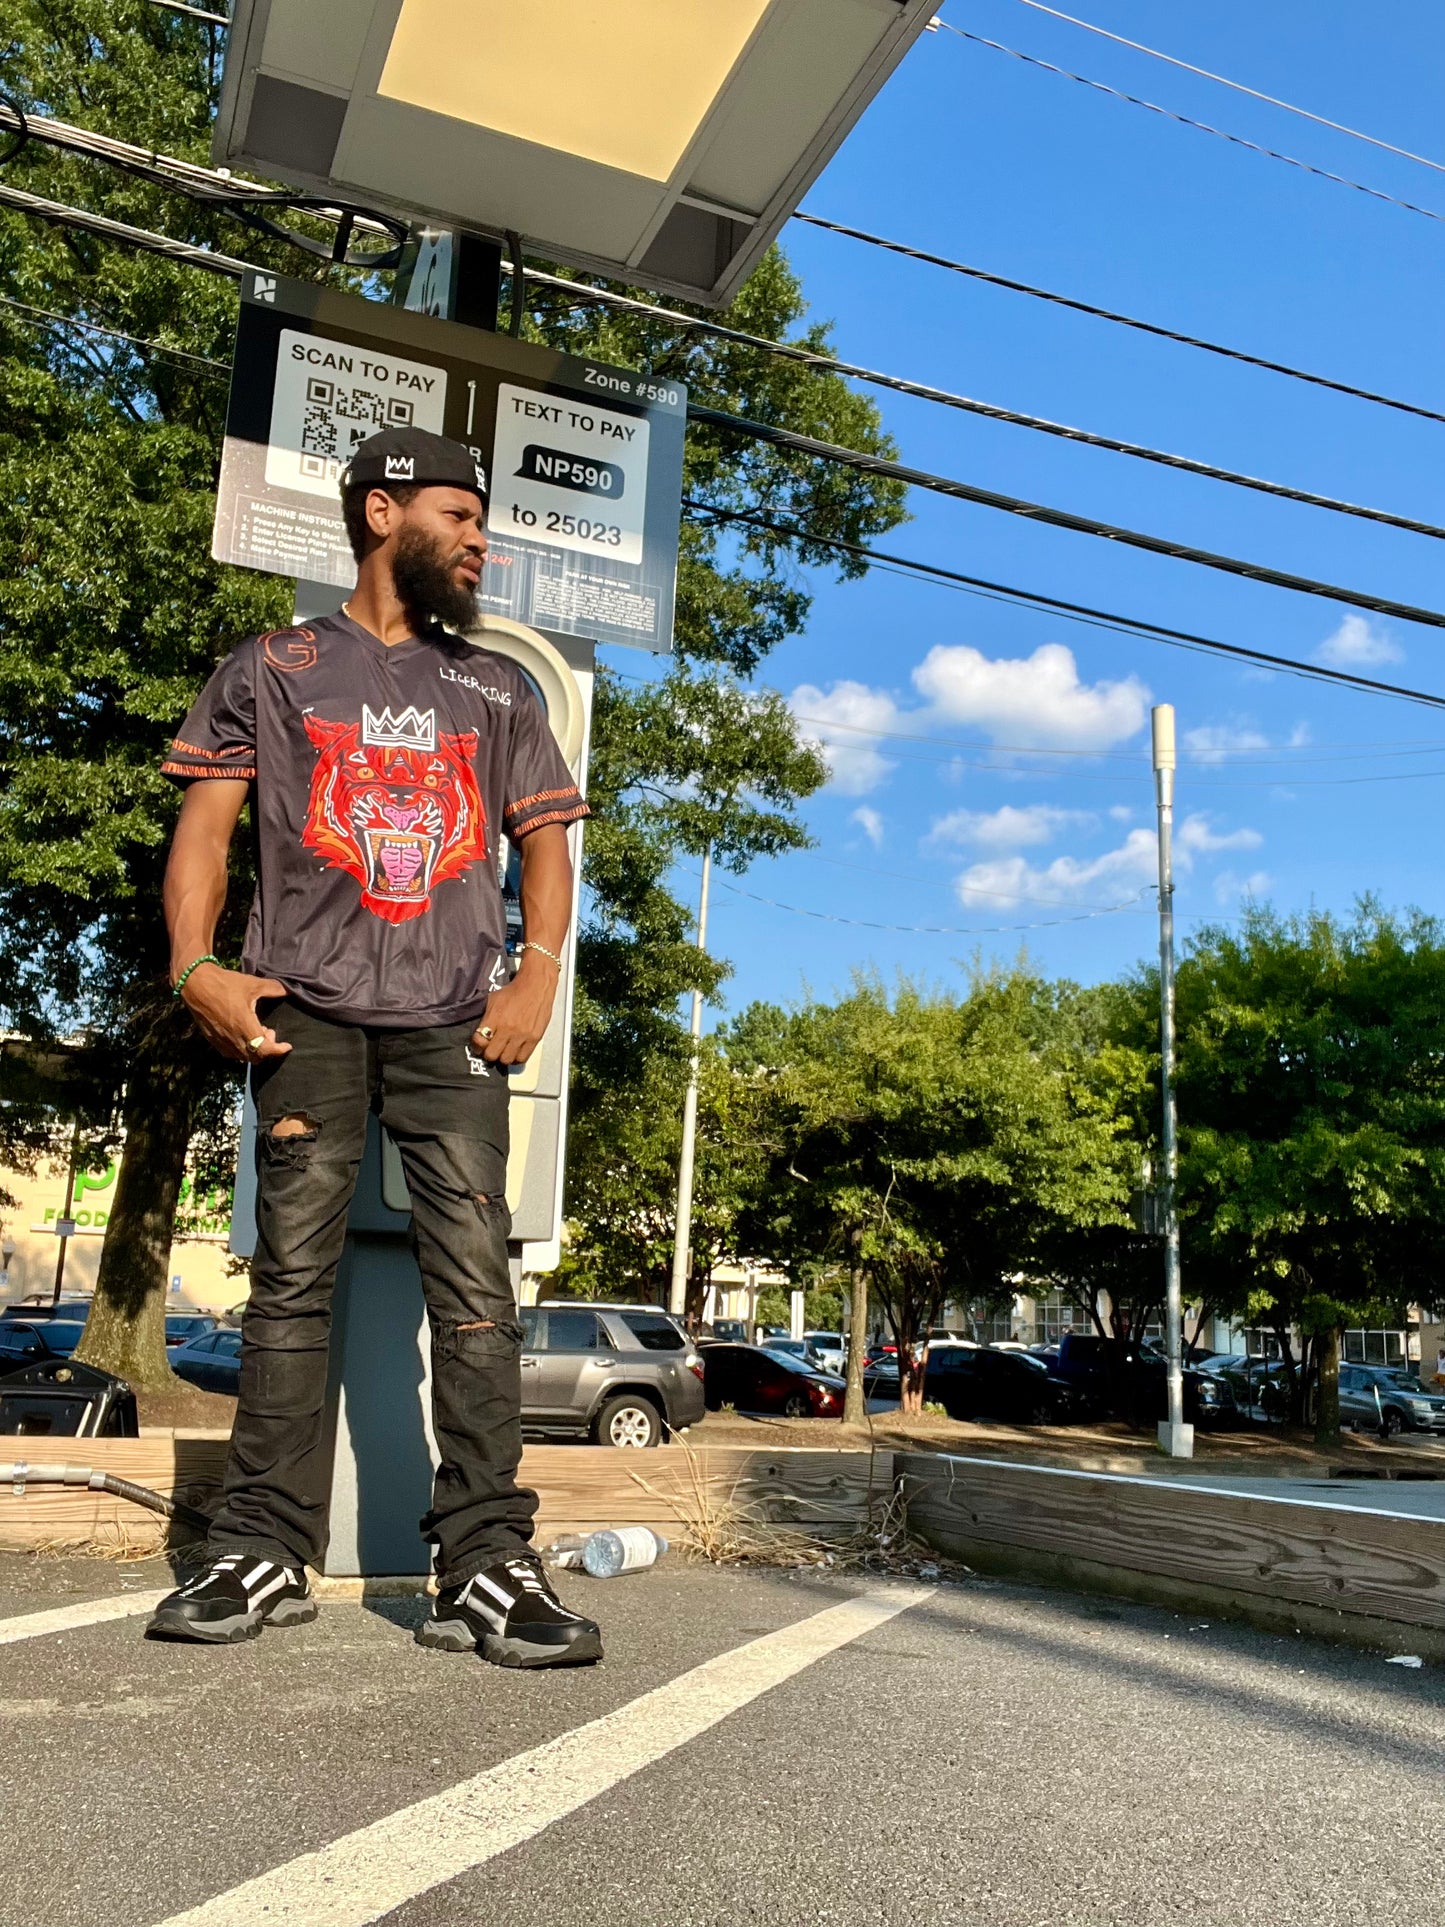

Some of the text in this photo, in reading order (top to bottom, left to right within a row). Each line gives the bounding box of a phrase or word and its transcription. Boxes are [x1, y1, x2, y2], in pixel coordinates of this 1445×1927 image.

[291, 344, 436, 393] SCAN TO PAY
[584, 367, 679, 406] Zone #590
[511, 397, 636, 442] TEXT TO PAY
[460, 443, 482, 463] R
[534, 454, 613, 491] NP590
[242, 515, 341, 543] 1. Press Any Key to Start
[251, 502, 347, 531] MACHINE INSTRUCT
[512, 503, 622, 547] to 25023
[241, 524, 354, 555] 2. Enter License Plate Numb
[251, 534, 276, 547] Select
[277, 540, 308, 554] Desired
[309, 547, 328, 558] Rate
[251, 544, 272, 556] Make
[273, 548, 308, 563] Payment
[491, 553, 513, 566] 24/7
[257, 627, 317, 673] G
